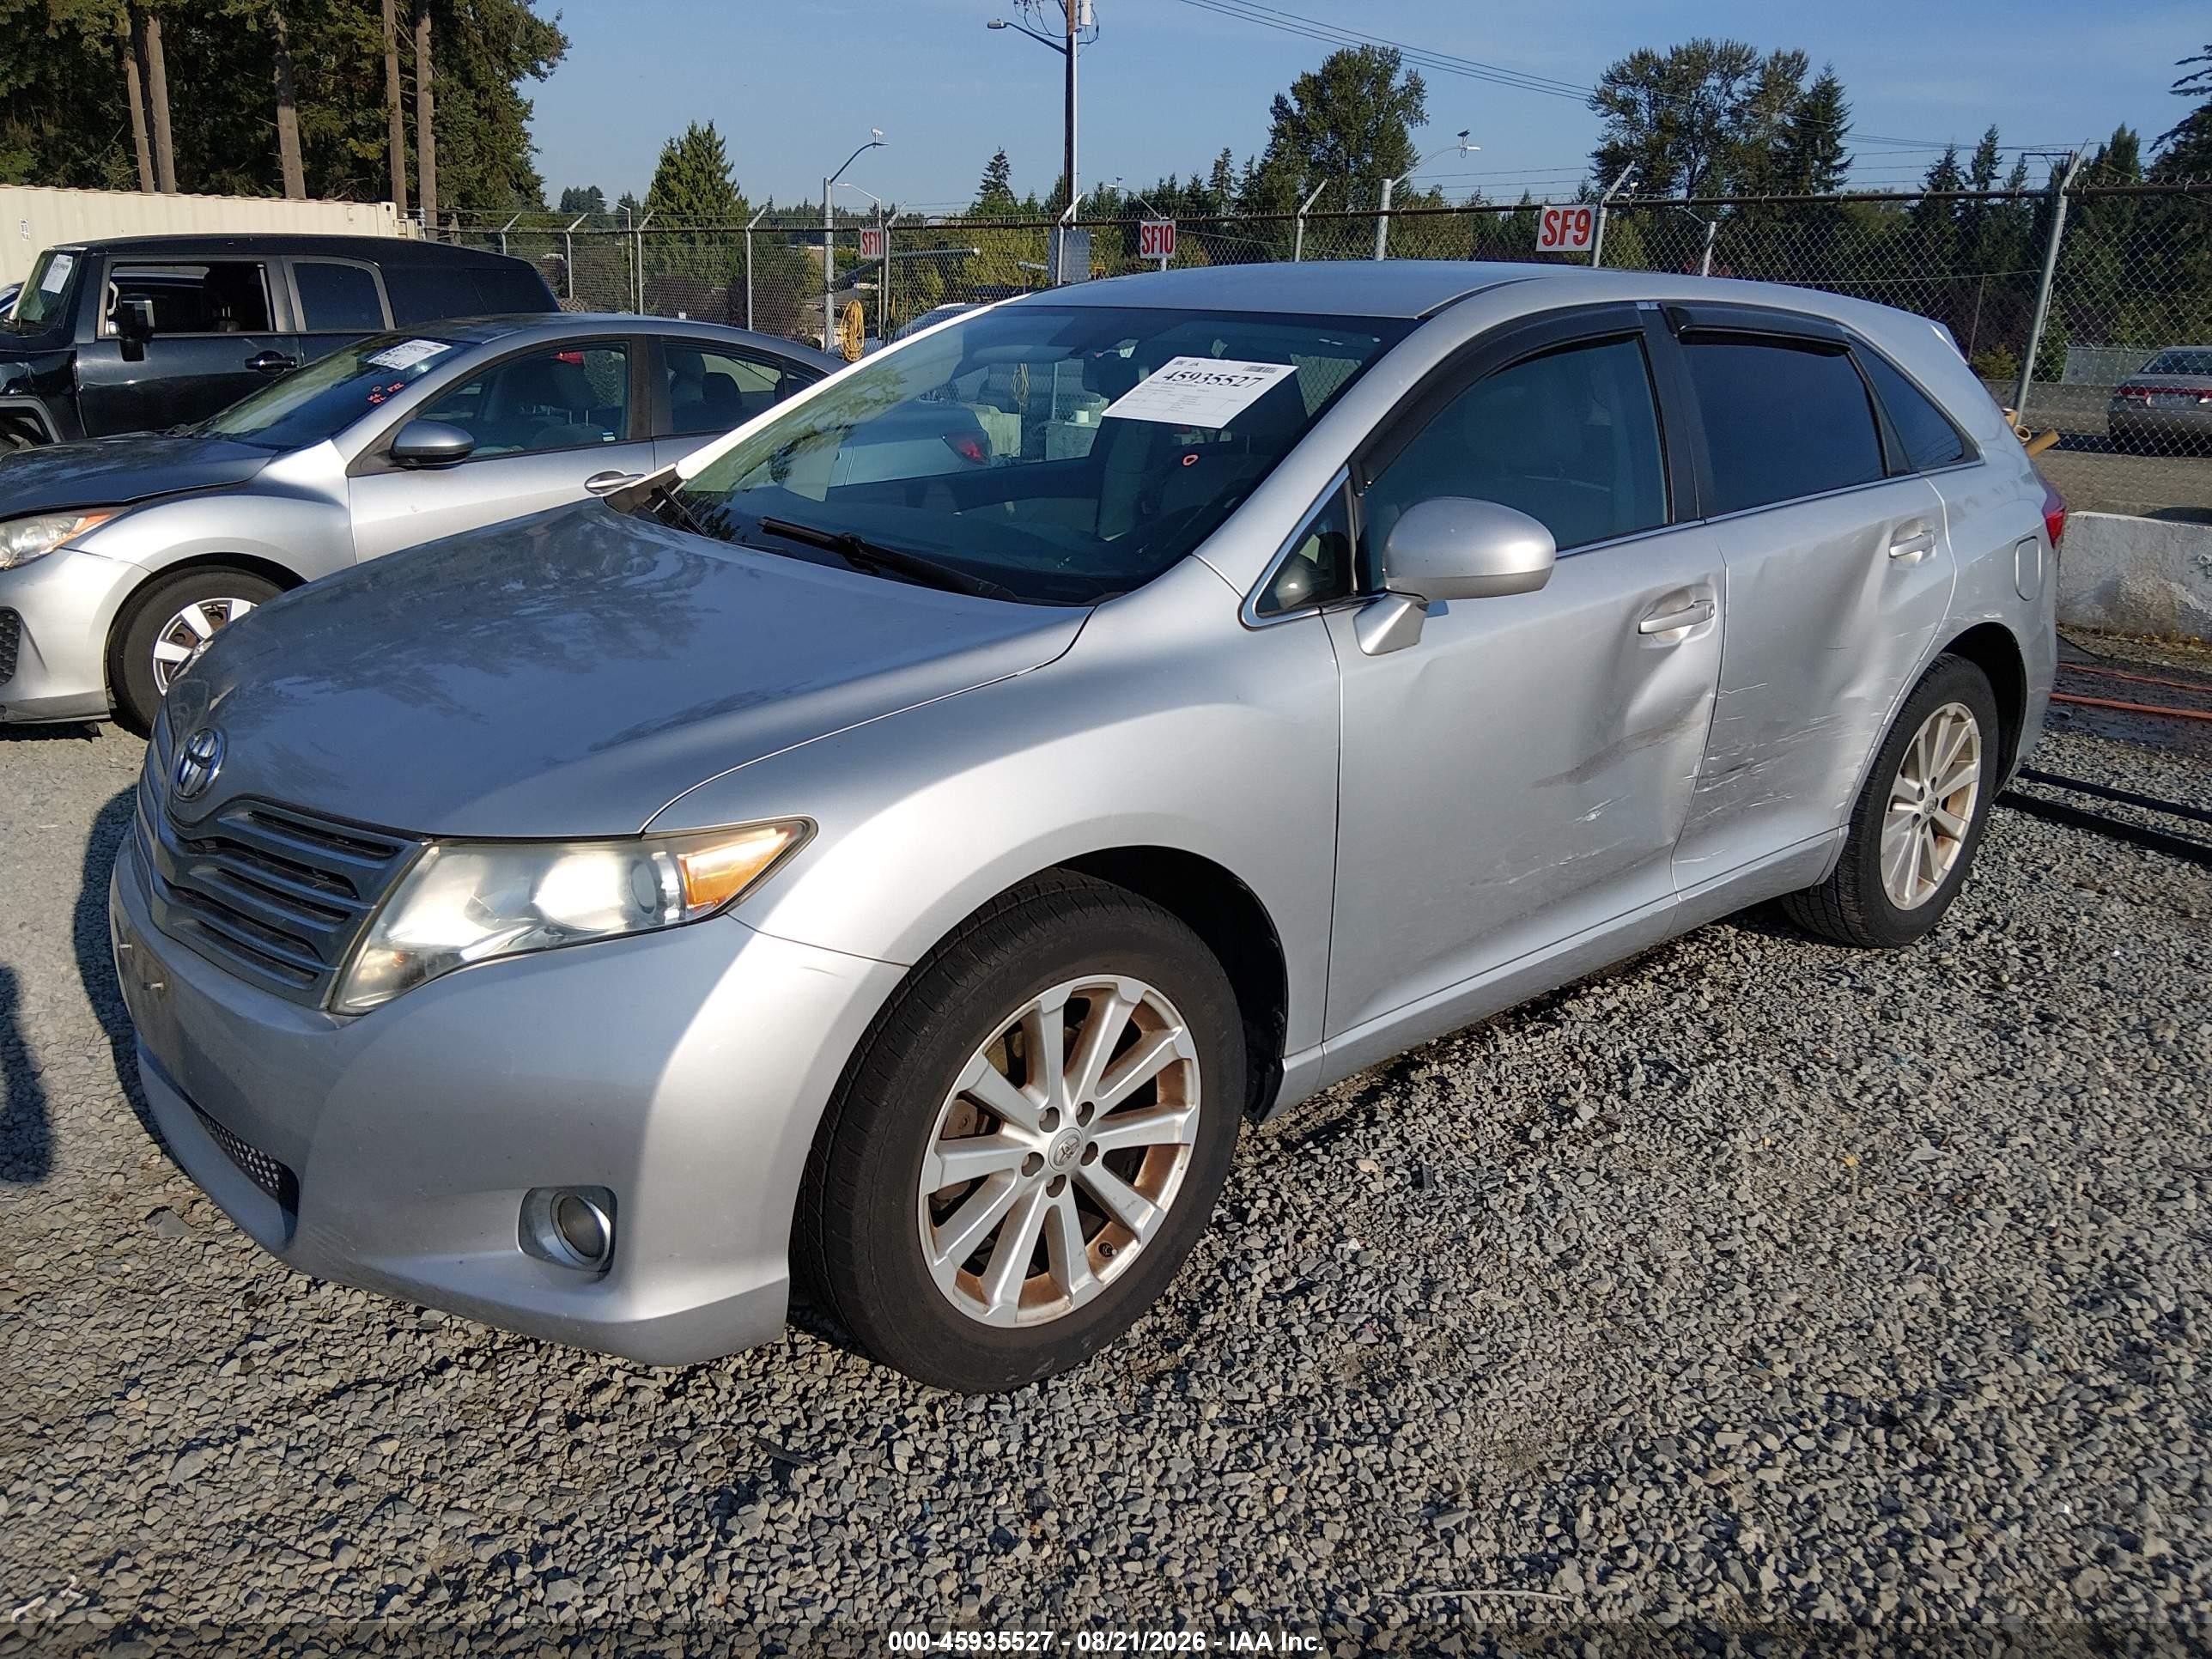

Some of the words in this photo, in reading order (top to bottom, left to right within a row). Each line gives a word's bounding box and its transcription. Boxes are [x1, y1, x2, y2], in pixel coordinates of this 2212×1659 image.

[1141, 225, 1174, 255] SF10
[1542, 209, 1591, 246] SF9
[862, 231, 882, 256] SF11
[1163, 370, 1265, 389] 45935527
